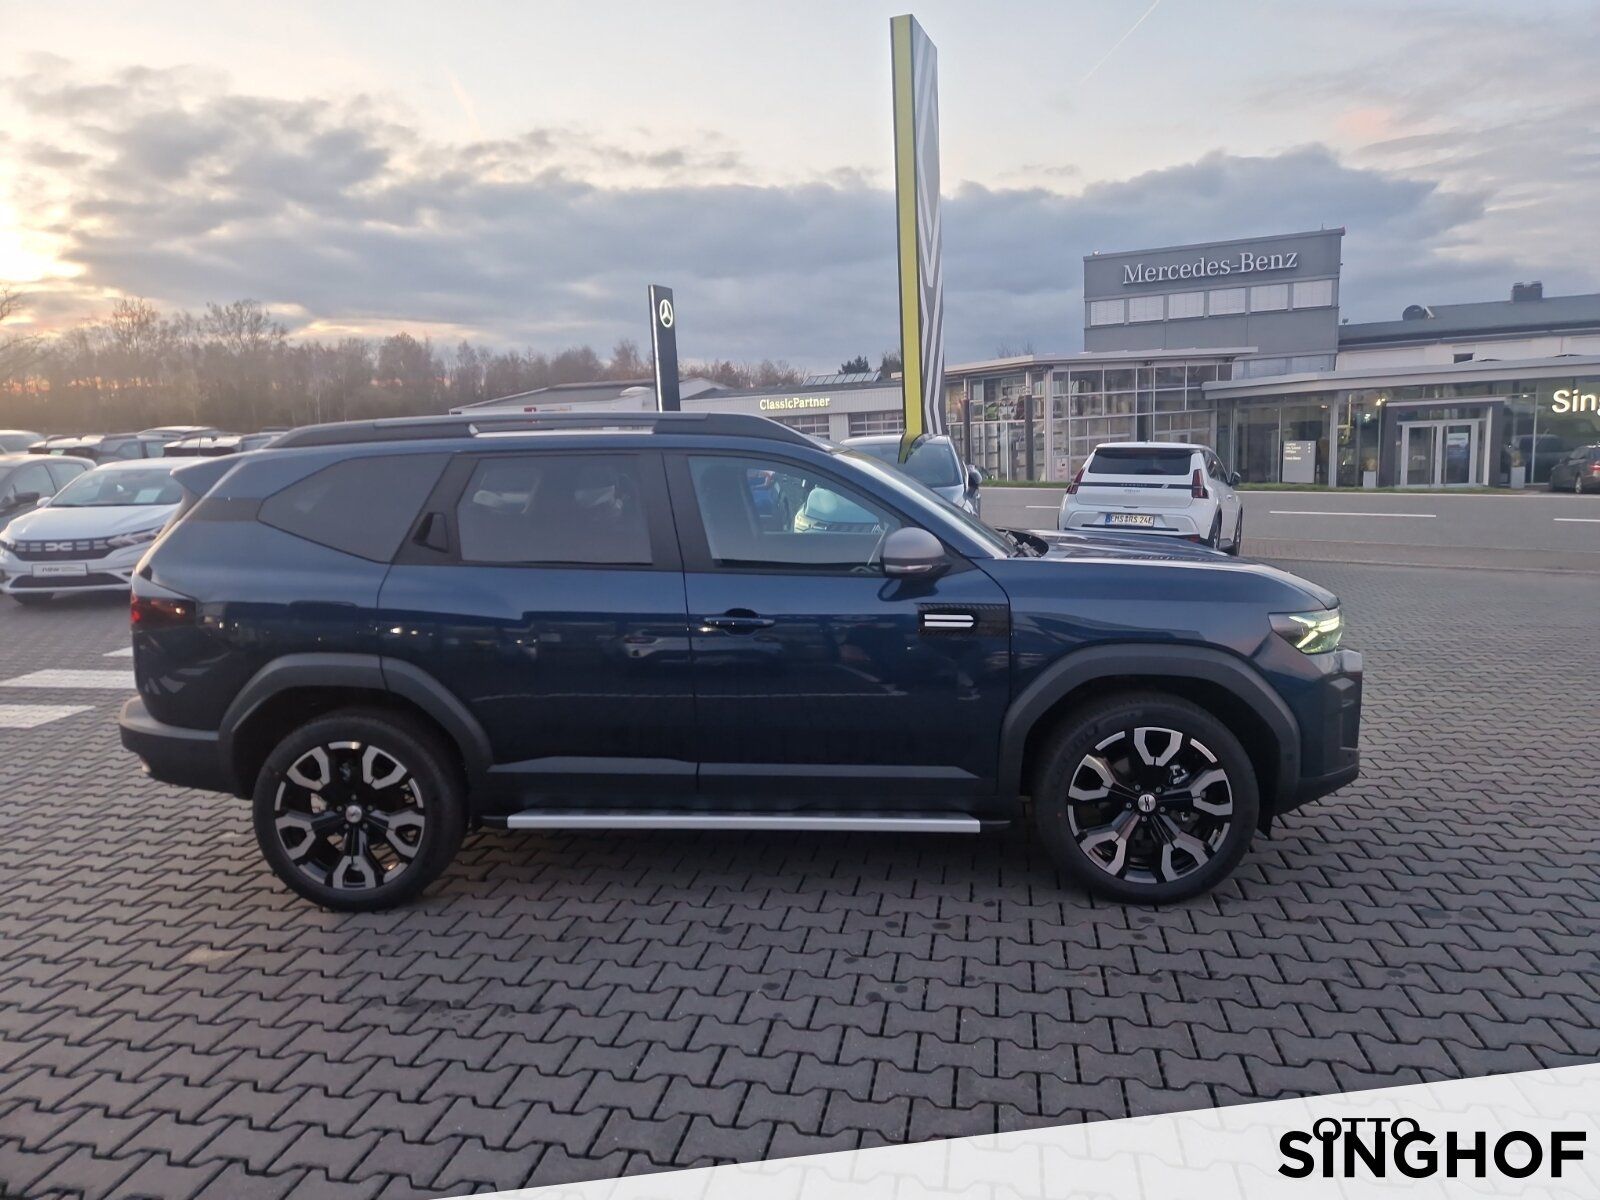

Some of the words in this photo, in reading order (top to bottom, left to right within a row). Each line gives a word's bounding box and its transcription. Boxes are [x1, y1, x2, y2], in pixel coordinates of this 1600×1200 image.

[1123, 251, 1298, 285] Mercedes-Benz
[759, 397, 830, 411] ClassicPartner
[1551, 389, 1600, 417] Sin
